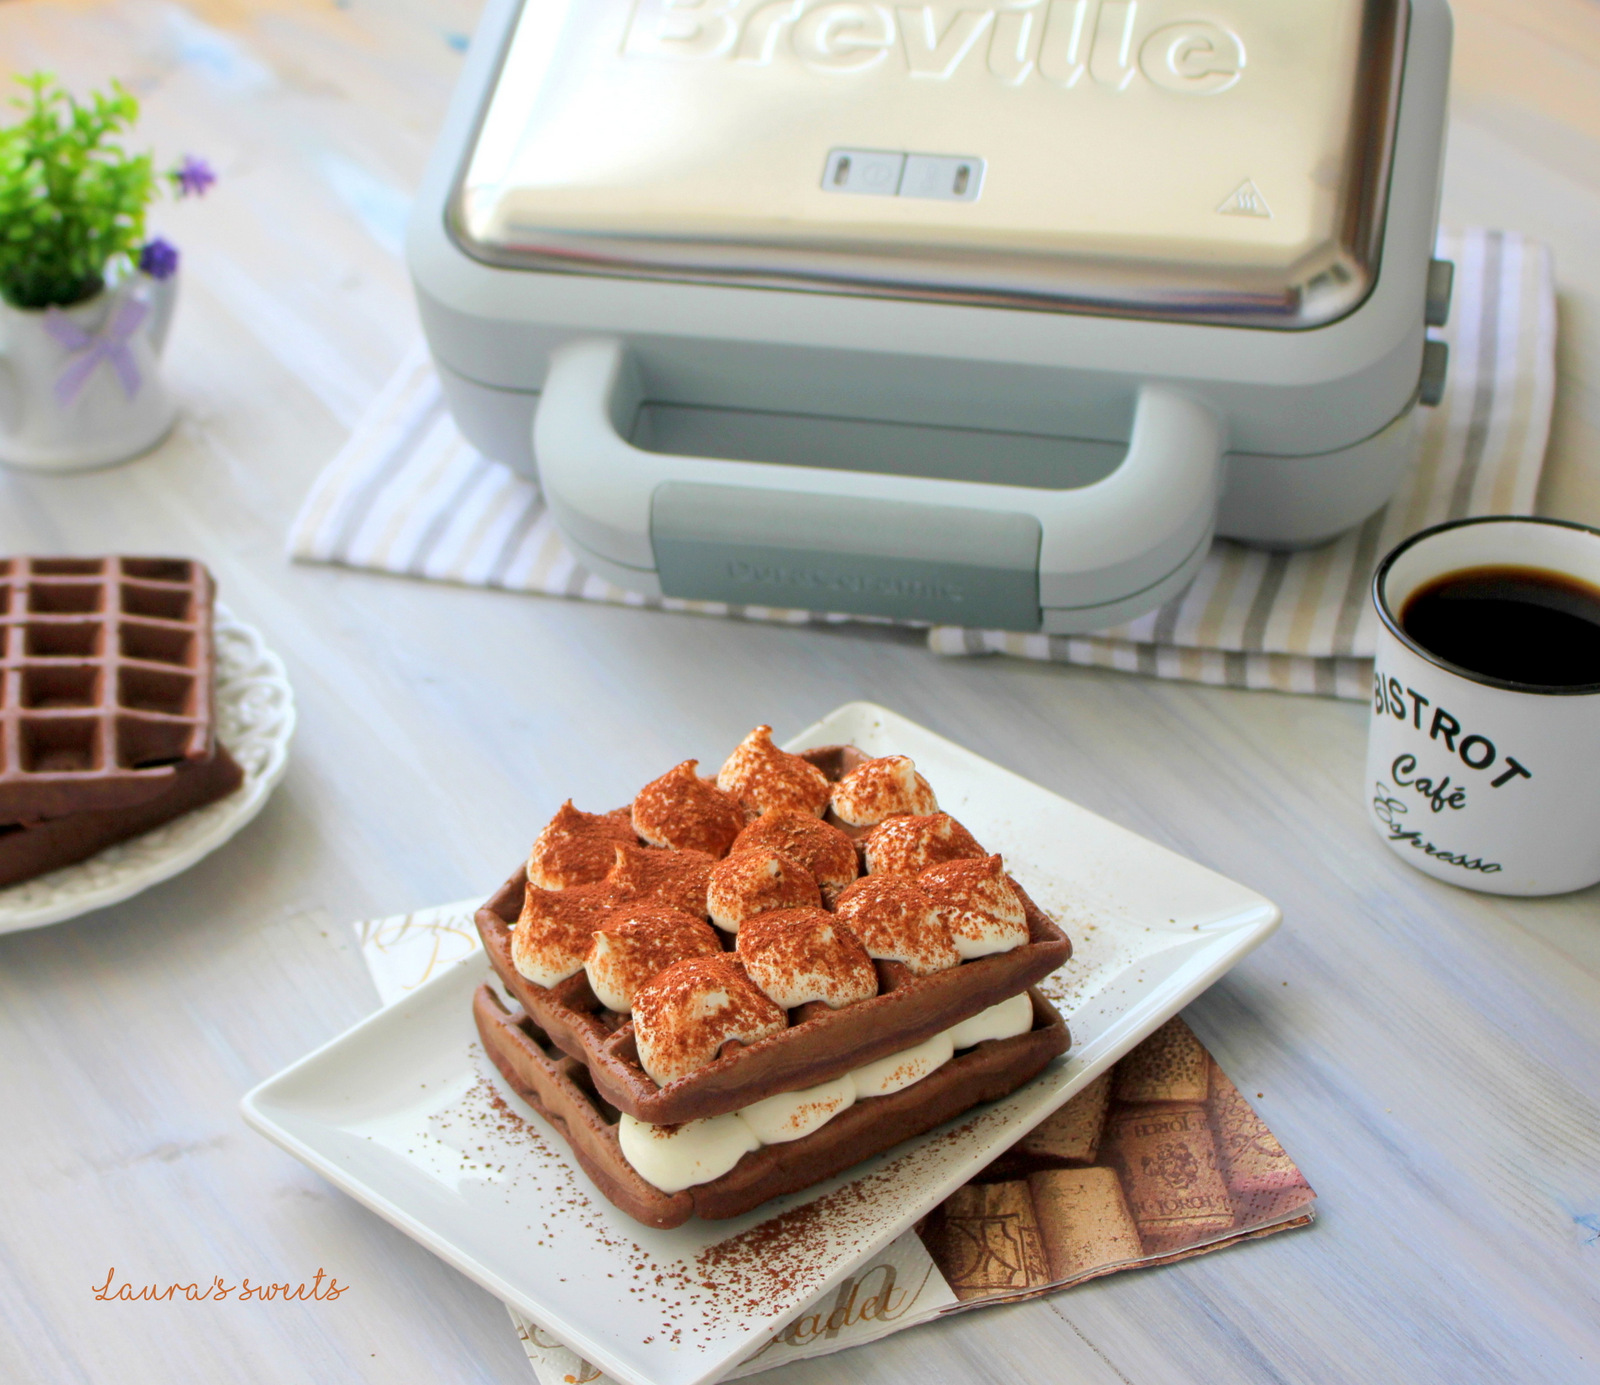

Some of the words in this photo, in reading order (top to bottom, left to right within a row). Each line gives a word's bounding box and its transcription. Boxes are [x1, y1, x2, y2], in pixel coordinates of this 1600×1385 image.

[619, 0, 1248, 94] Breville
[1374, 672, 1532, 788] BISTROT
[1373, 781, 1503, 874] Espresso
[1391, 753, 1467, 813] Café
